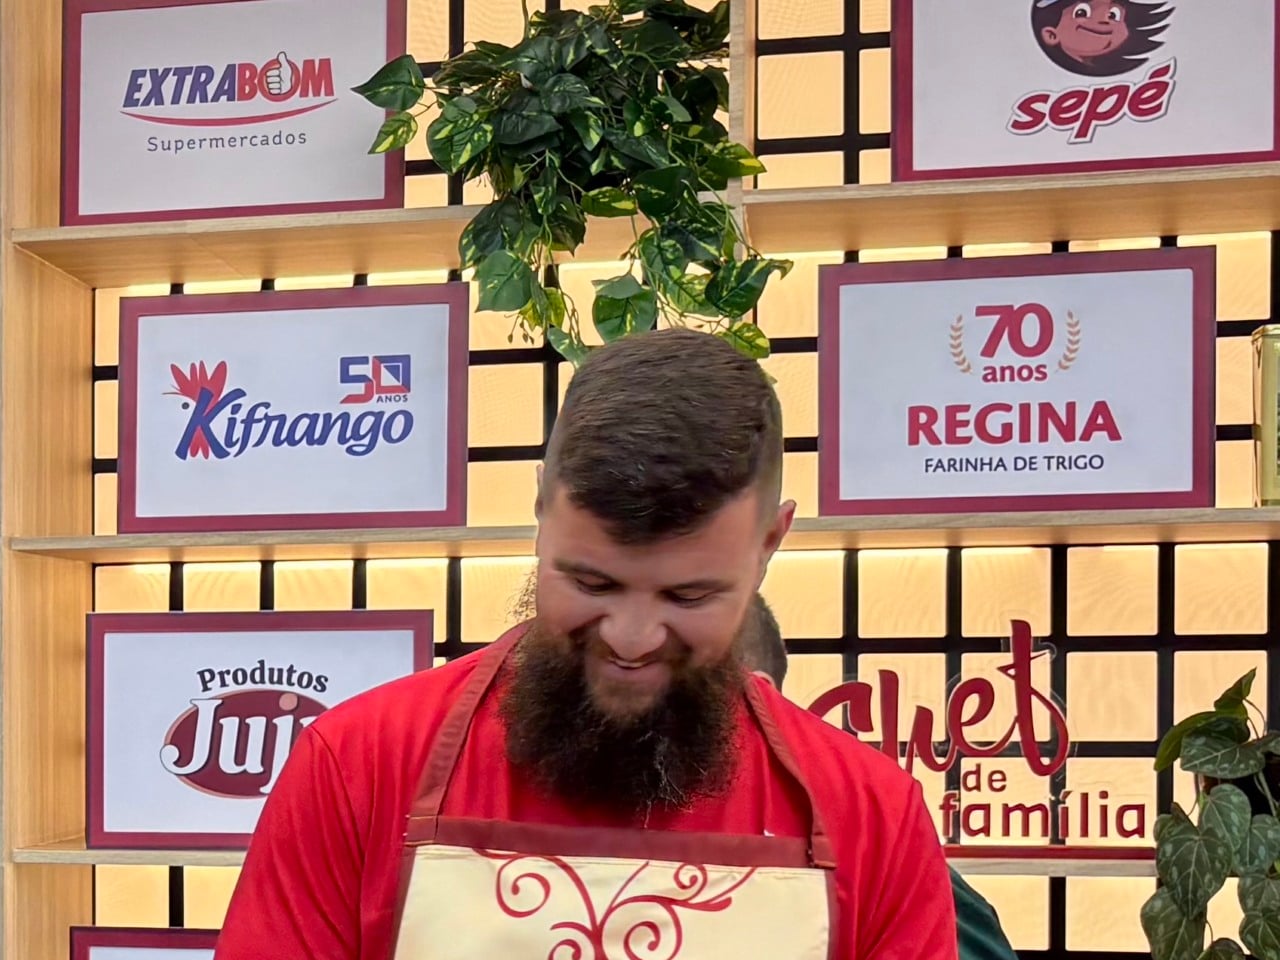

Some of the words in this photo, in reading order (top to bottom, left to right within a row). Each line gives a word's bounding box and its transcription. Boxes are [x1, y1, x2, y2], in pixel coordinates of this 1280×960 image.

[122, 52, 334, 108] EXTRABOM
[1009, 60, 1174, 142] sepé
[147, 131, 307, 154] Supermercados
[975, 302, 1054, 358] 70
[339, 354, 411, 404] 50
[982, 364, 1048, 383] anos
[376, 393, 409, 404] ANOS
[174, 386, 414, 460] Kifrango
[907, 400, 1122, 447] REGINA
[924, 456, 1008, 474] FARINHA
[1013, 456, 1038, 471] DE
[1043, 454, 1105, 471] TRIGO
[196, 659, 329, 693] Produtos
[160, 693, 320, 795] Juj
[961, 763, 1007, 792] de
[939, 789, 1146, 839] família
